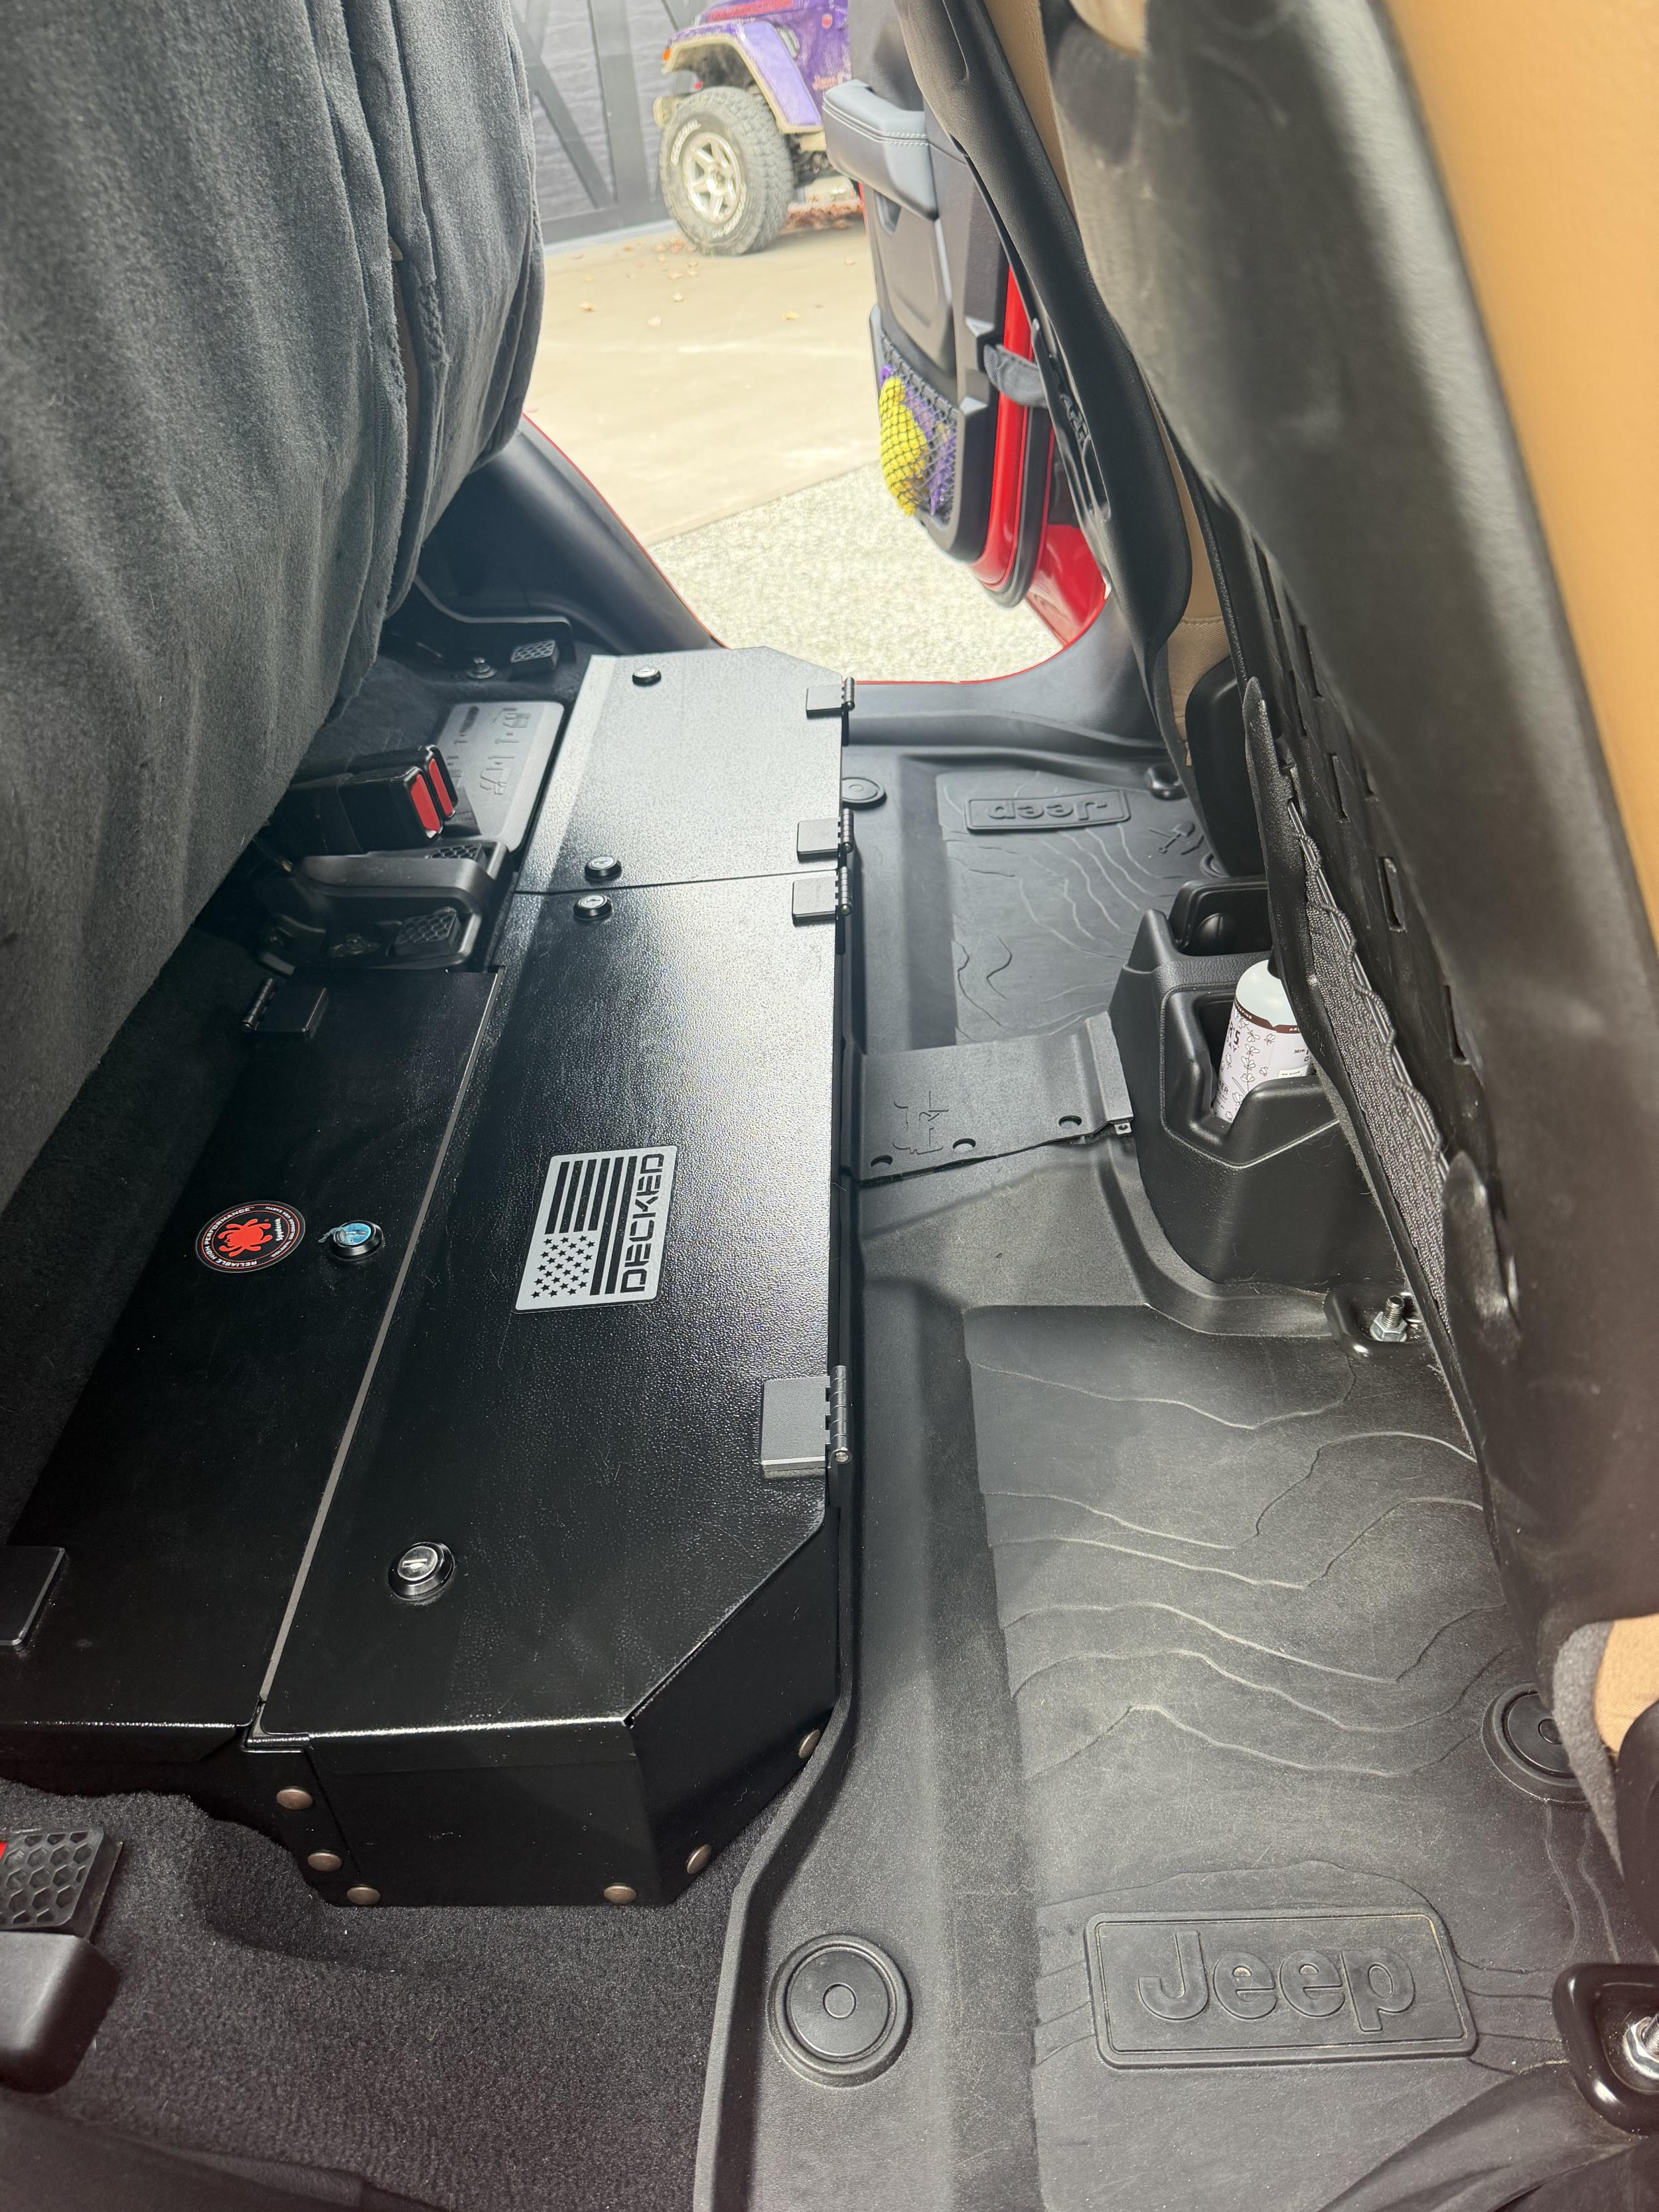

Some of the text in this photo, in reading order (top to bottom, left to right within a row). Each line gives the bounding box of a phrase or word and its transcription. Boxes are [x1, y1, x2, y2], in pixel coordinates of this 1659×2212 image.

[986, 800, 1108, 822] Jeep
[275, 1217, 284, 1242] Spyderco
[620, 1153, 664, 1293] DECKED
[204, 1246, 218, 1260] HIGH
[216, 1258, 257, 1267] RELIABLE
[1138, 1930, 1416, 2033] Jeep
